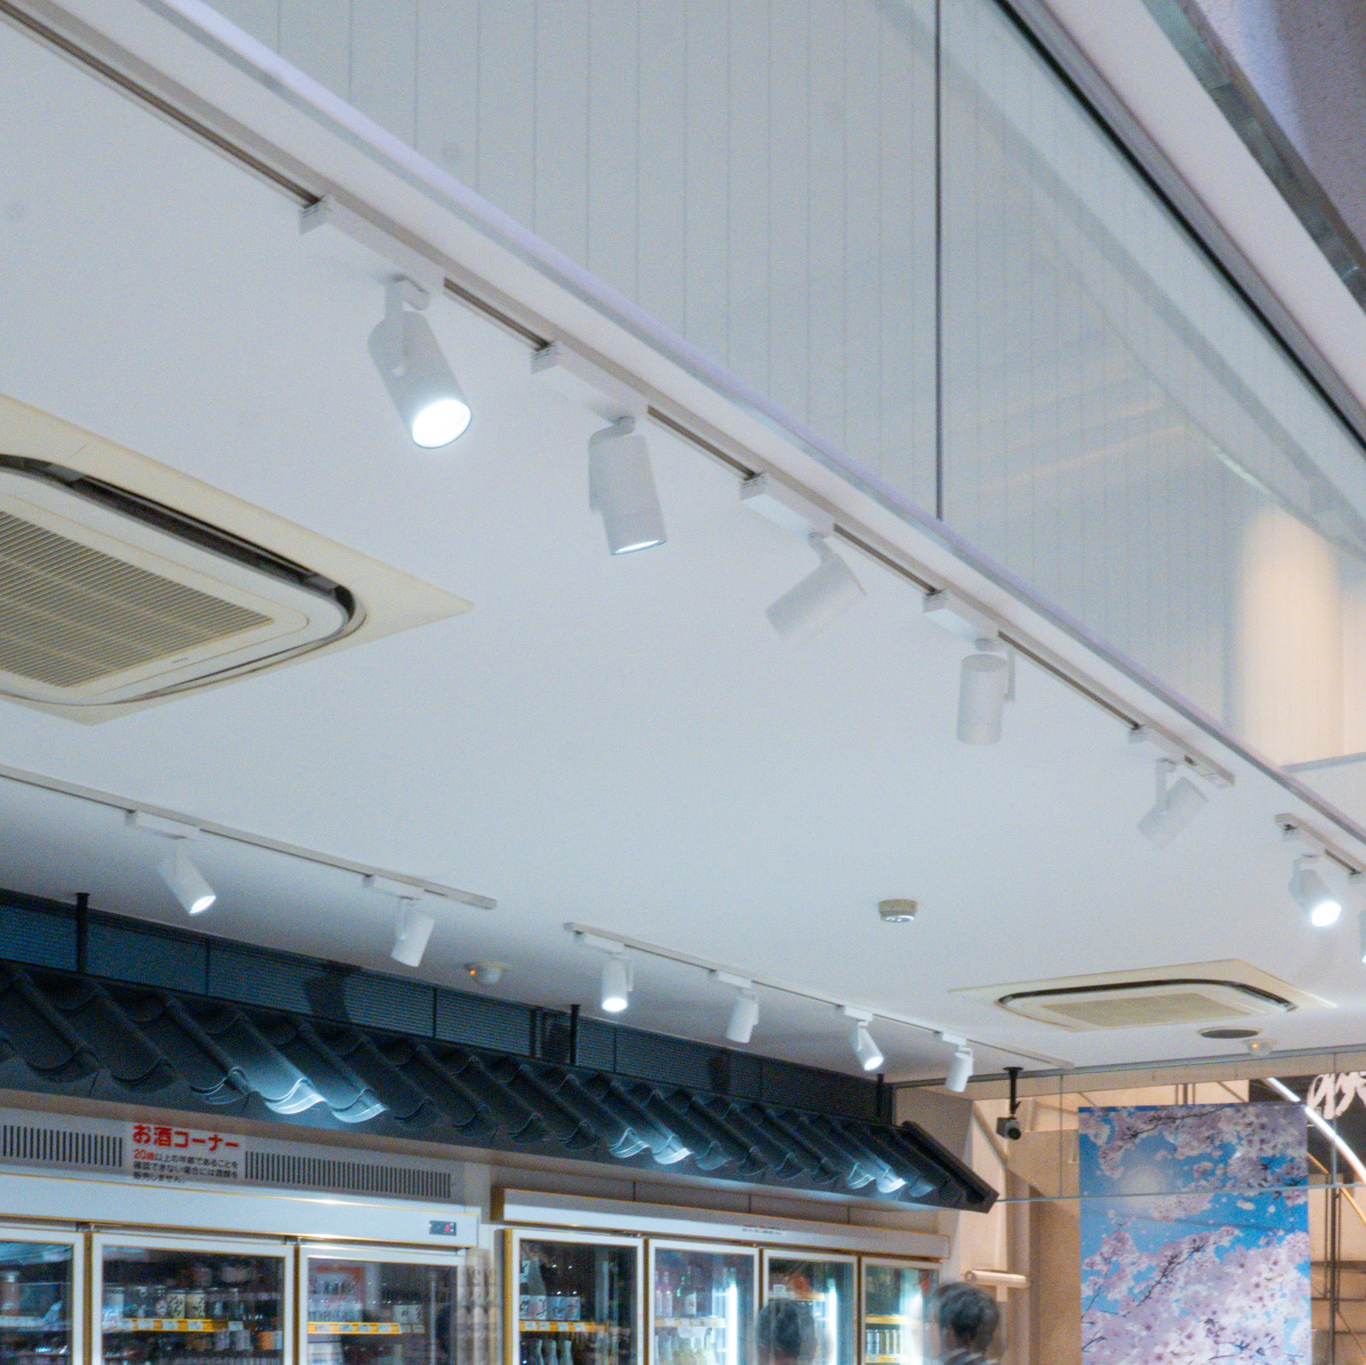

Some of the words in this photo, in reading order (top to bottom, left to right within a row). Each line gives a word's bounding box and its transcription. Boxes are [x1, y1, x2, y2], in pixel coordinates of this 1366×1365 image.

[133, 1125, 239, 1152] お酒コーナー
